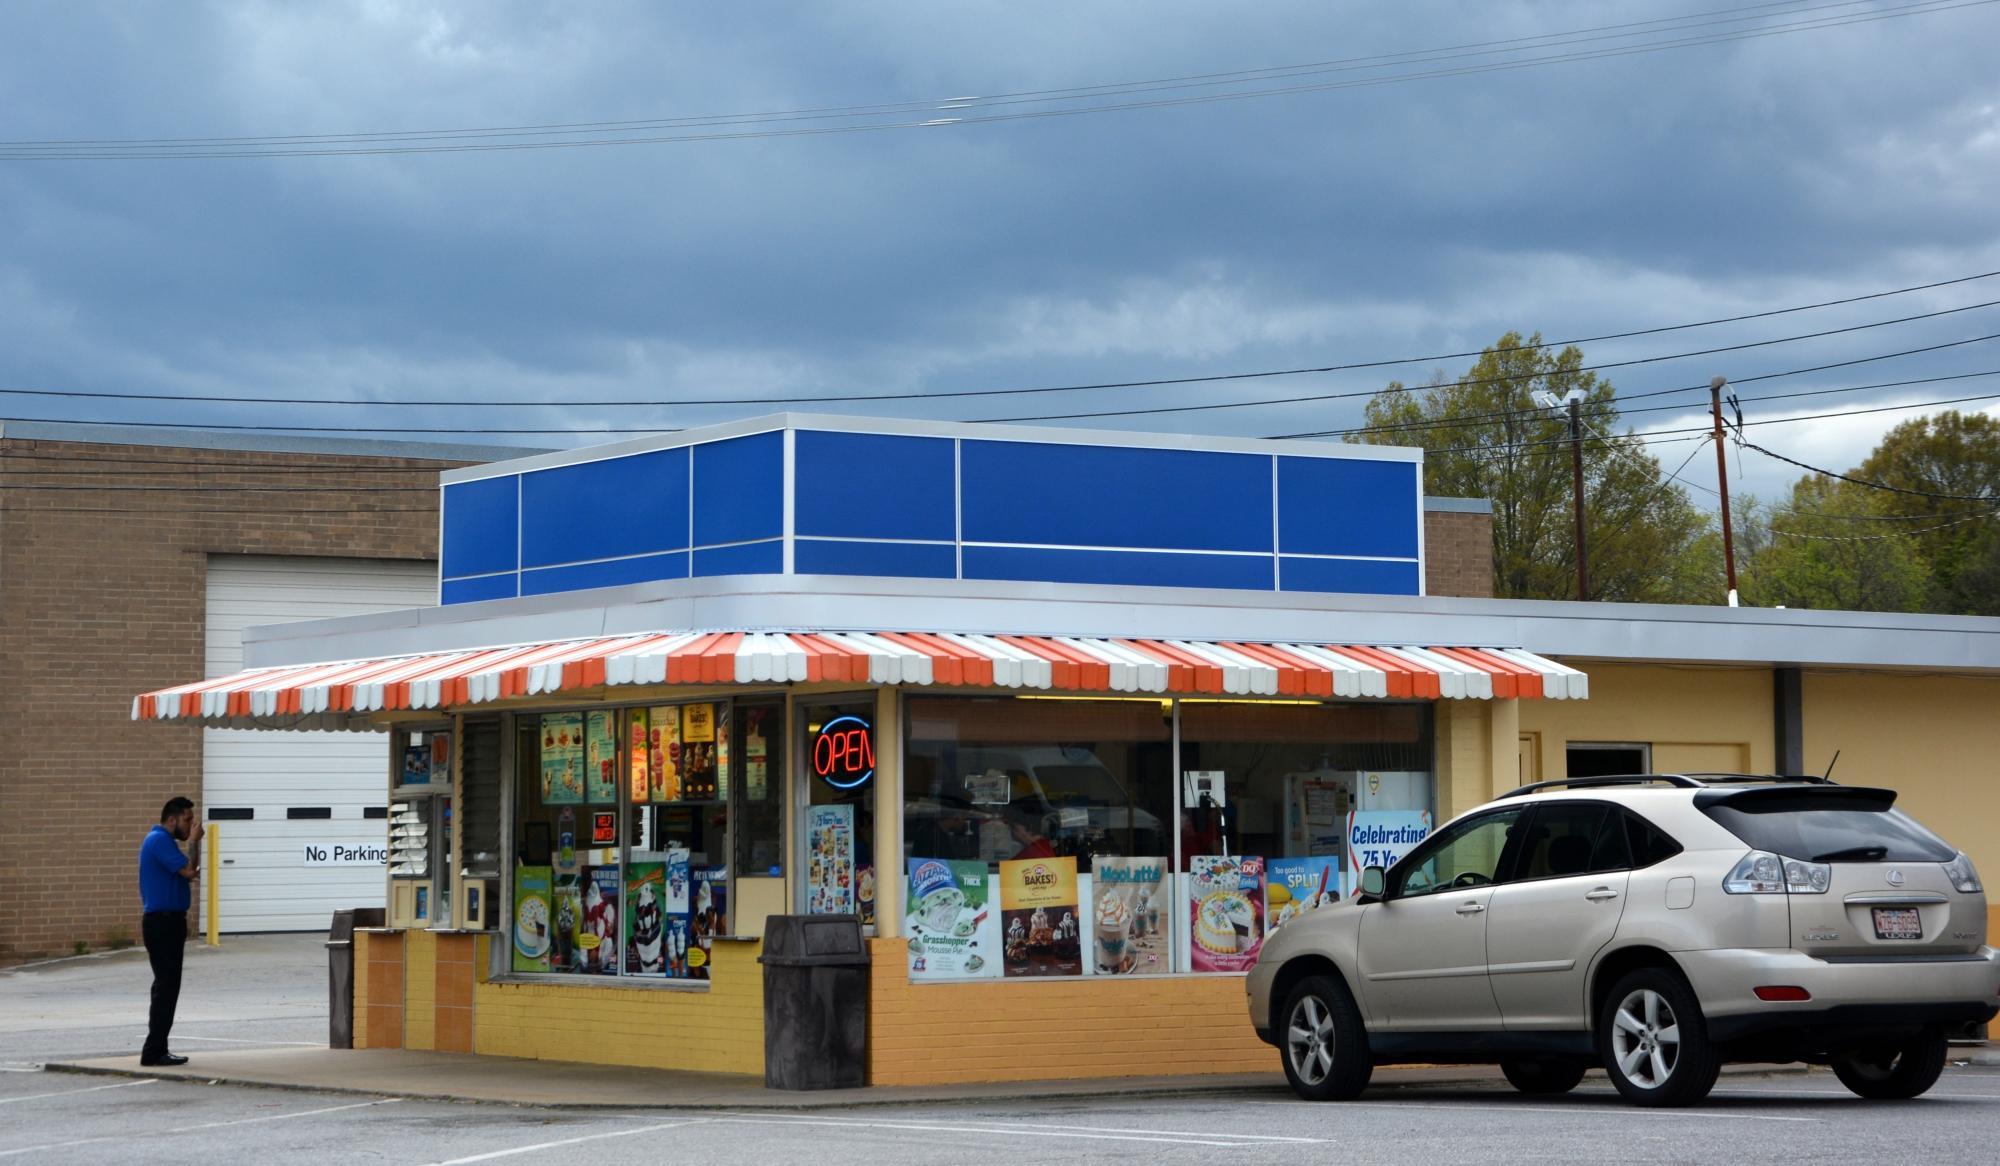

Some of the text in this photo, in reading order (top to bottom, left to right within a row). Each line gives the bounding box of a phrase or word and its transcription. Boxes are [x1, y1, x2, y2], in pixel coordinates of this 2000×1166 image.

[815, 730, 875, 775] OPEN
[1352, 825, 1427, 845] Celebrating
[306, 845, 388, 864] No Parking
[1363, 851, 1379, 866] 75
[1241, 864, 1257, 873] DQ
[1275, 866, 1284, 874] Too
[1284, 866, 1298, 875] good
[1024, 874, 1054, 886] BAKES!
[1288, 873, 1320, 888] SPLIT
[922, 934, 969, 946] Grasshopper
[928, 945, 963, 954] Mousse Pie
